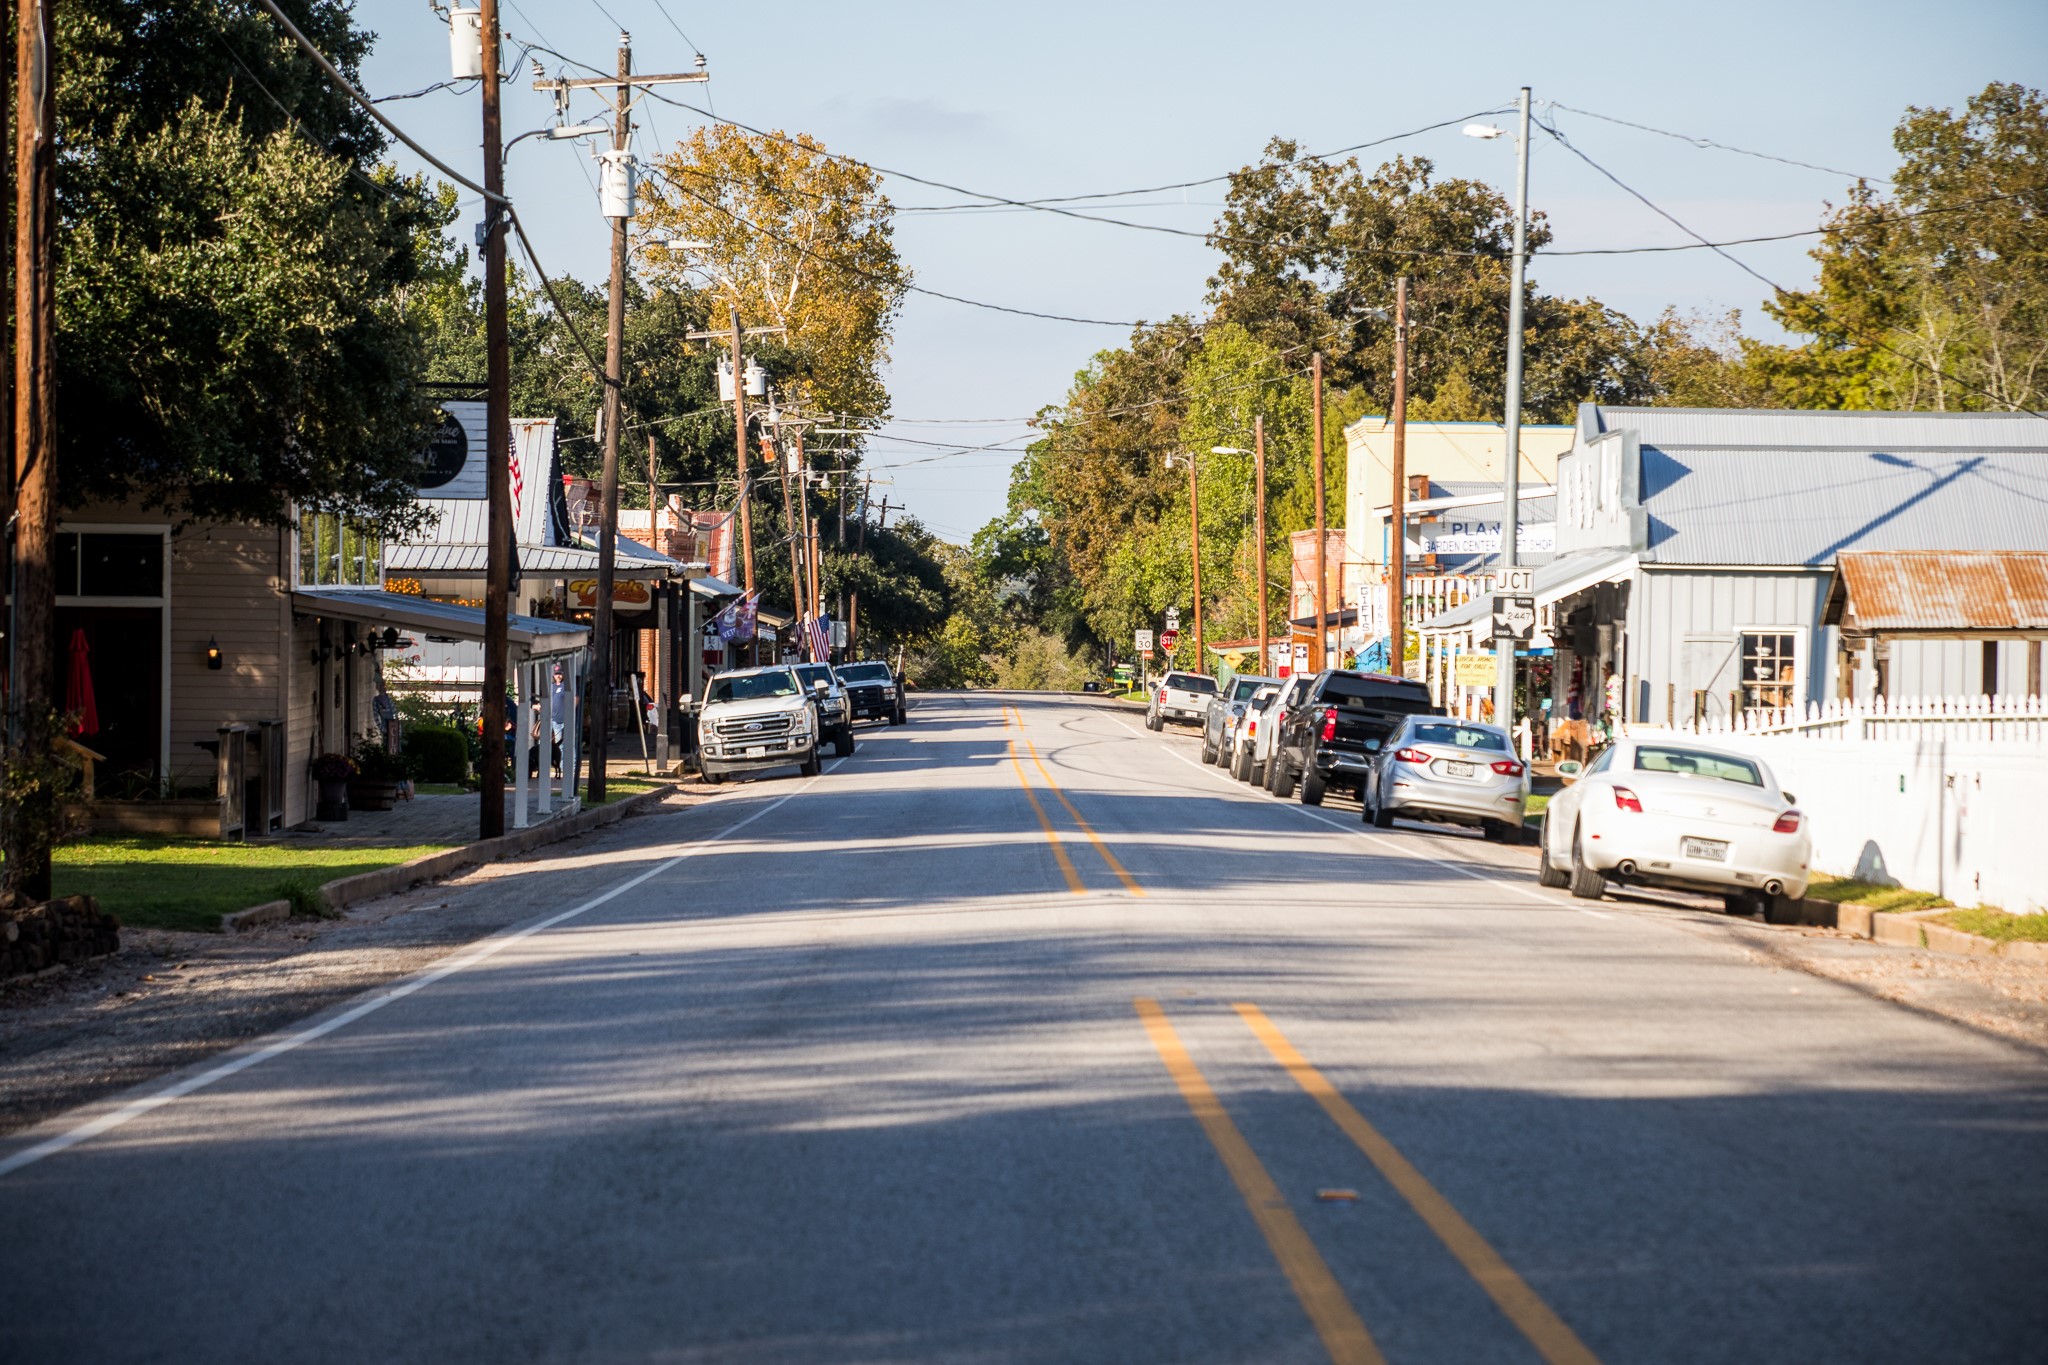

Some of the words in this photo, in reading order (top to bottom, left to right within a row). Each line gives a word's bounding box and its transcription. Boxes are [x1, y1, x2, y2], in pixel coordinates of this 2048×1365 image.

[1452, 522, 1524, 536] PLANS
[1425, 540, 1460, 552] GARDEN
[1463, 540, 1497, 552] CENTER
[1529, 539, 1552, 552] SHOP
[1499, 572, 1532, 589] JCT
[1360, 586, 1369, 632] GIFTS
[1507, 612, 1531, 620] 2447
[1138, 641, 1151, 649] 30
